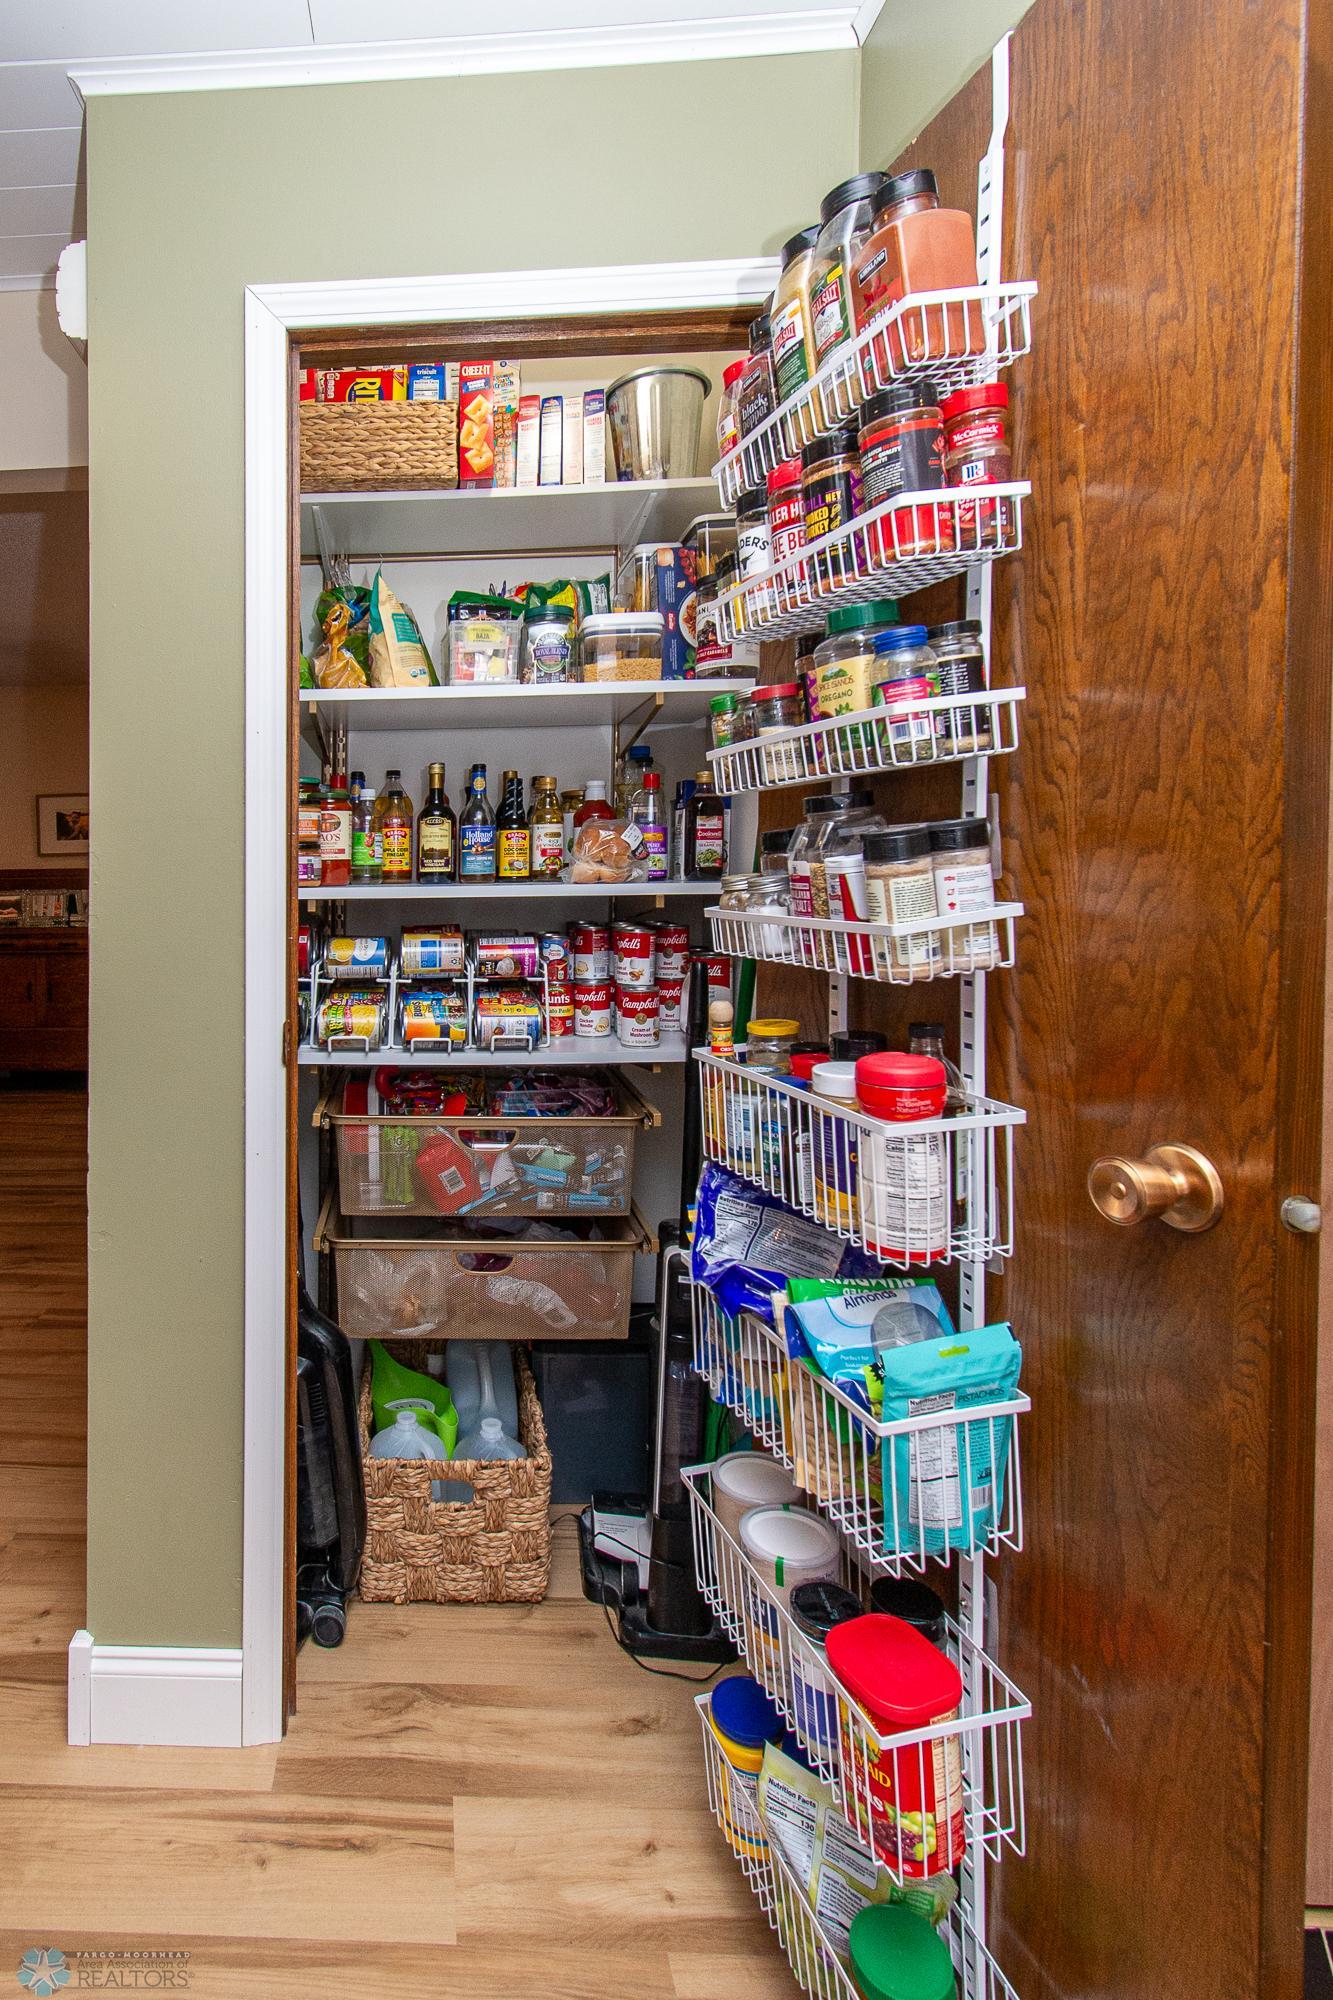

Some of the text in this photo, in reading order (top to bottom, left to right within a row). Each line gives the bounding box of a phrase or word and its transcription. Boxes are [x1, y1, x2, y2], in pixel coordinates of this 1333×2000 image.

[353, 377, 382, 402] RIT
[820, 688, 853, 704] OREGANO
[575, 989, 606, 1002] ampbell's
[843, 1289, 898, 1310] Almonds
[768, 1777, 797, 1799] Nutrition
[797, 1794, 817, 1808] Facts
[800, 1820, 815, 1832] 130
